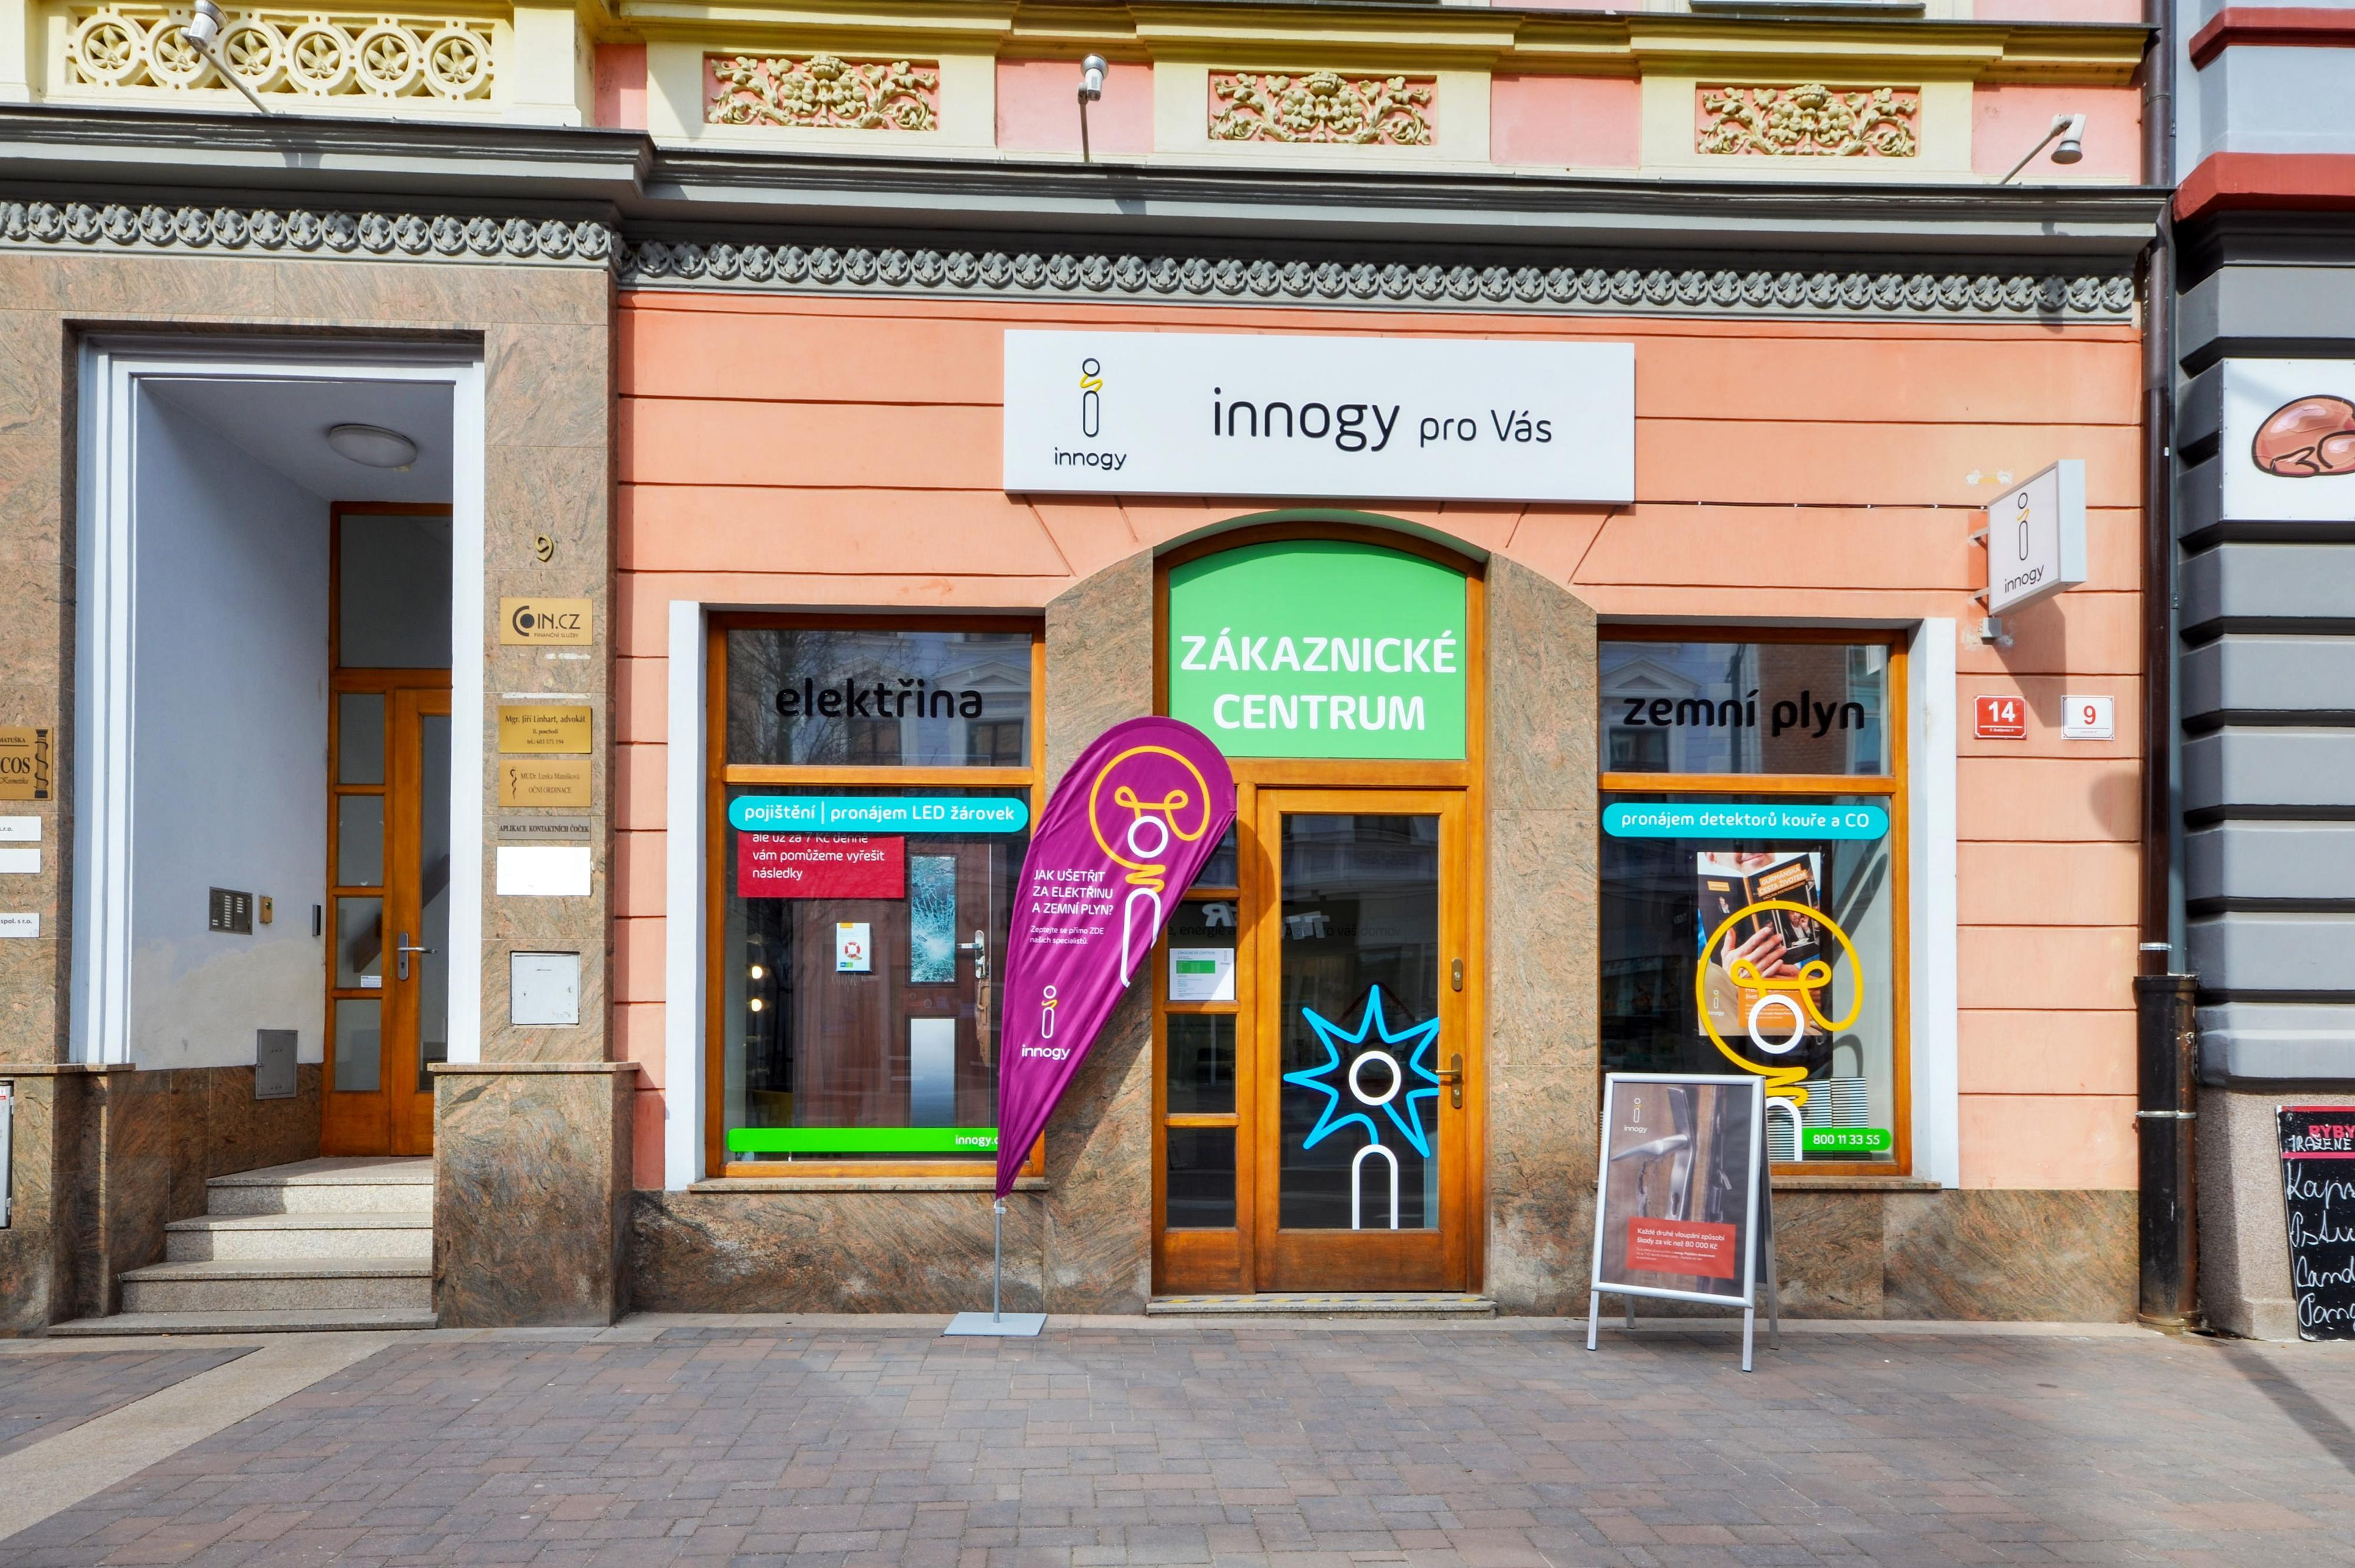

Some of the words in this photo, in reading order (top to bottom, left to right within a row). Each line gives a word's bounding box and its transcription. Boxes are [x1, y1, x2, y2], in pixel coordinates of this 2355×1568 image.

[1213, 386, 1401, 453] innogy
[1419, 414, 1477, 448] pro
[1491, 409, 1553, 443] Vás
[1054, 446, 1127, 471] innogy
[534, 534, 554, 562] 9
[2004, 564, 2044, 594] innogy
[1180, 627, 1457, 673] ZÁKAZNICKÉ
[775, 677, 983, 719] elektřina
[1213, 693, 1425, 730] CENTRUM
[1623, 689, 1759, 726] zemní
[1772, 690, 1865, 738] plyn
[1988, 700, 2016, 723] 14
[2083, 705, 2097, 725] 9
[505, 715, 520, 725] Mgr.
[533, 715, 558, 723] Linhart,
[560, 715, 585, 723] advokát
[745, 805, 816, 822] pojištění
[831, 805, 907, 823] pronájem
[913, 805, 944, 820] LED
[950, 805, 1014, 820] žárovek
[1621, 811, 1694, 828] pronájem
[1699, 811, 1777, 827] detektorů
[1782, 812, 1826, 827] kouře
[1831, 816, 1840, 827] a
[1845, 813, 1869, 828] CO
[529, 824, 568, 832] KONTAKTNÍCH
[570, 824, 589, 833] ČOČEK
[752, 833, 769, 842] ale
[772, 833, 785, 842] už
[789, 834, 801, 842] za
[806, 832, 812, 842] 7
[815, 833, 830, 843] Kč
[752, 849, 777, 861] vám
[780, 849, 843, 863] pomůžeme
[847, 850, 885, 863] vyřešit
[752, 867, 803, 881] následky
[1034, 869, 1054, 881] JAK
[1057, 868, 1106, 882] UŠETŘIT
[1033, 886, 1049, 897] ZA
[1052, 885, 1113, 899] ELEKTŘINU
[1031, 902, 1040, 913] A
[1043, 902, 1080, 914] ZEMNÍ
[1081, 903, 1114, 915] PLYN?
[1030, 925, 1058, 935] Zeptejte
[1069, 926, 1089, 935] přímo
[1337, 923, 1357, 936] váš
[1053, 937, 1089, 945] specialistů.
[1021, 1044, 1070, 1059] innogy
[1624, 1124, 1647, 1134] innogy
[1813, 1134, 1835, 1145] 800
[1837, 1135, 1846, 1145] 11
[1849, 1135, 1863, 1145] 33
[1866, 1135, 1880, 1145] 55
[1637, 1237, 1654, 1245] škody
[1675, 1231, 1700, 1241] vloupání
[1701, 1233, 1726, 1242] způsobí
